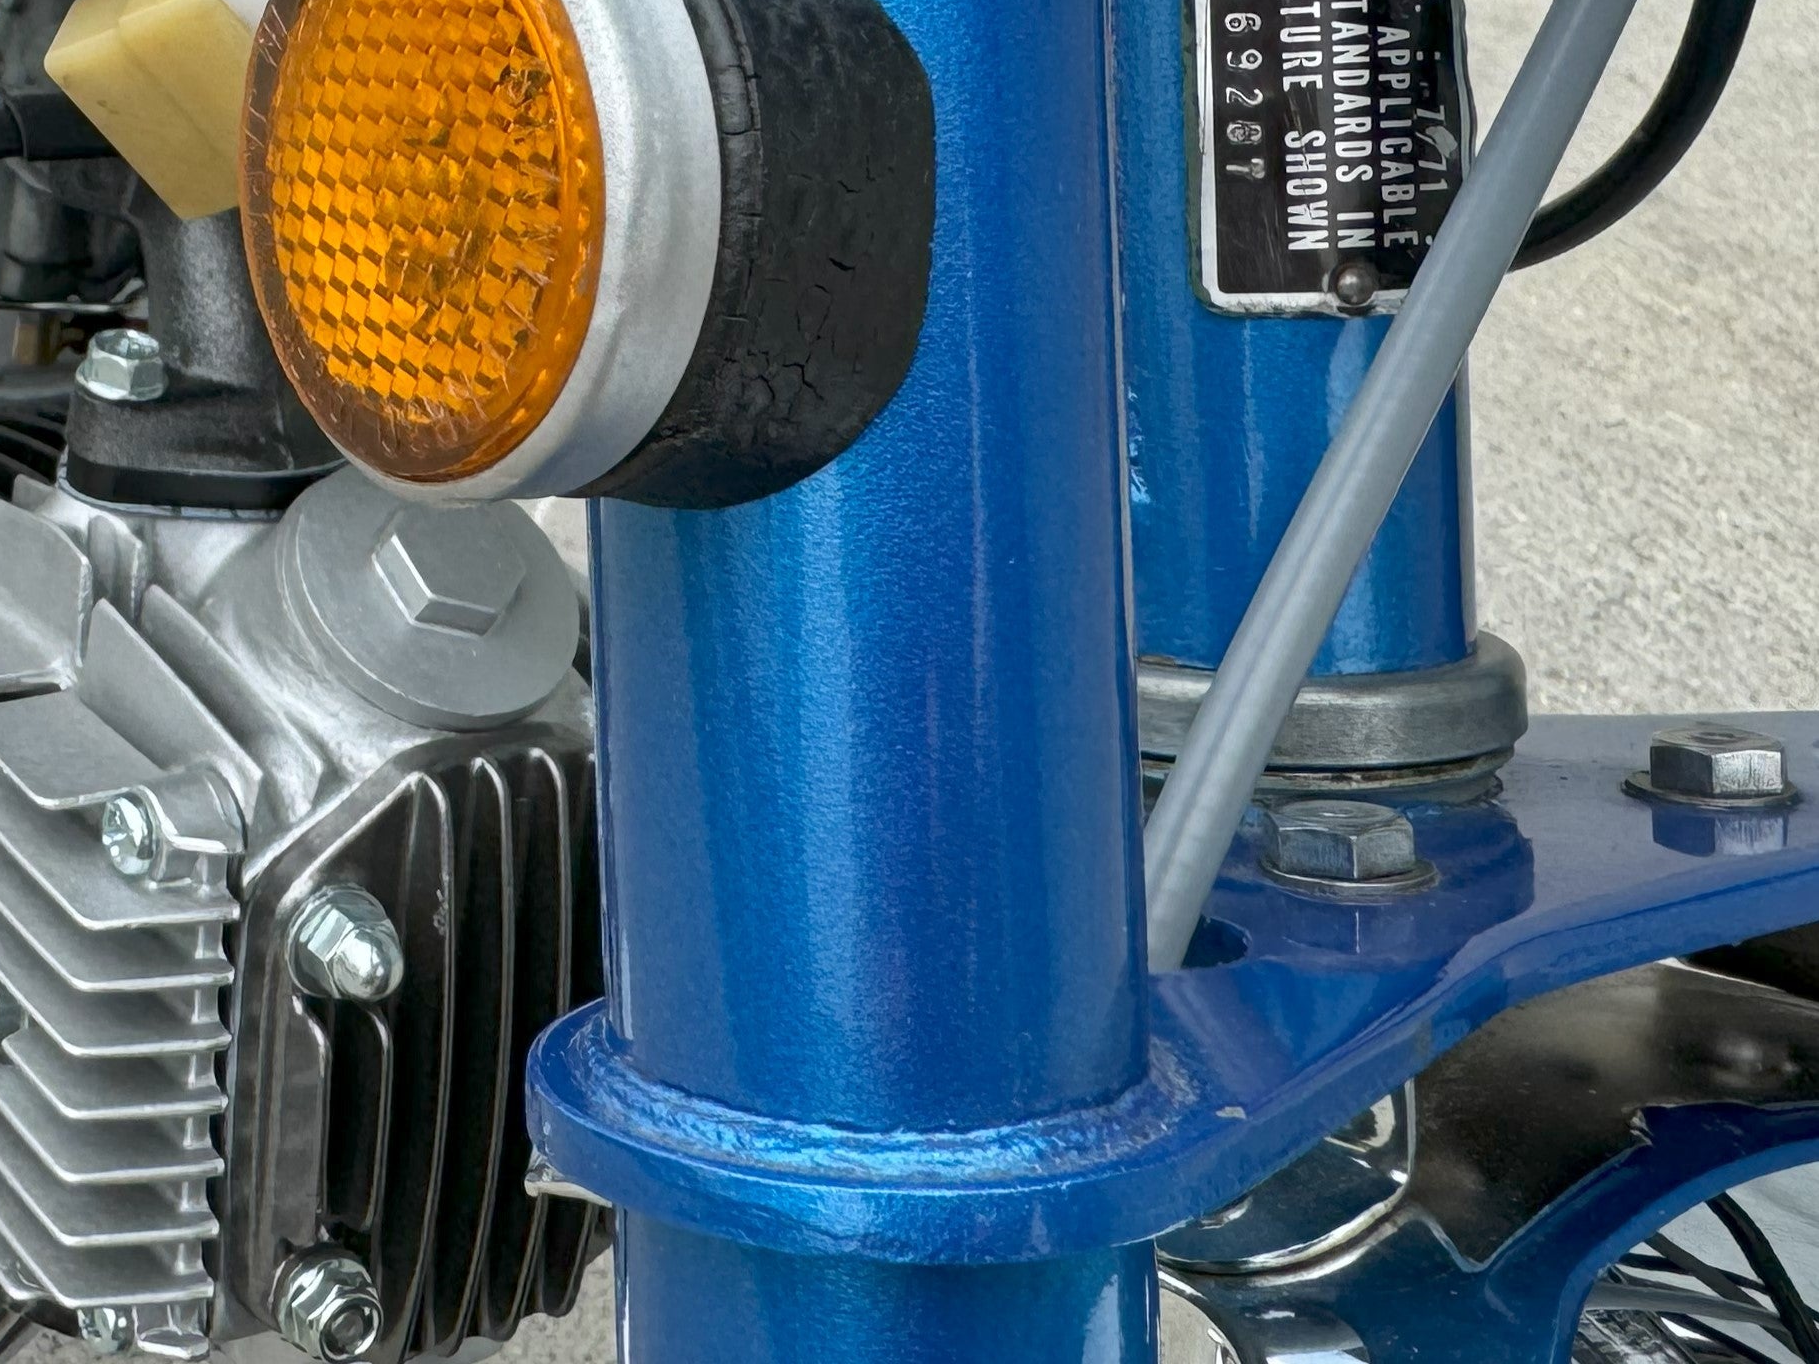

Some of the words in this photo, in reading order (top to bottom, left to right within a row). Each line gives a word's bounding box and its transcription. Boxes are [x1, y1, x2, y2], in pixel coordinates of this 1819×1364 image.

[1283, 129, 1330, 251] SHOWN
[1376, 25, 1419, 248] APPLICABLE
[1335, 211, 1377, 250] IN
